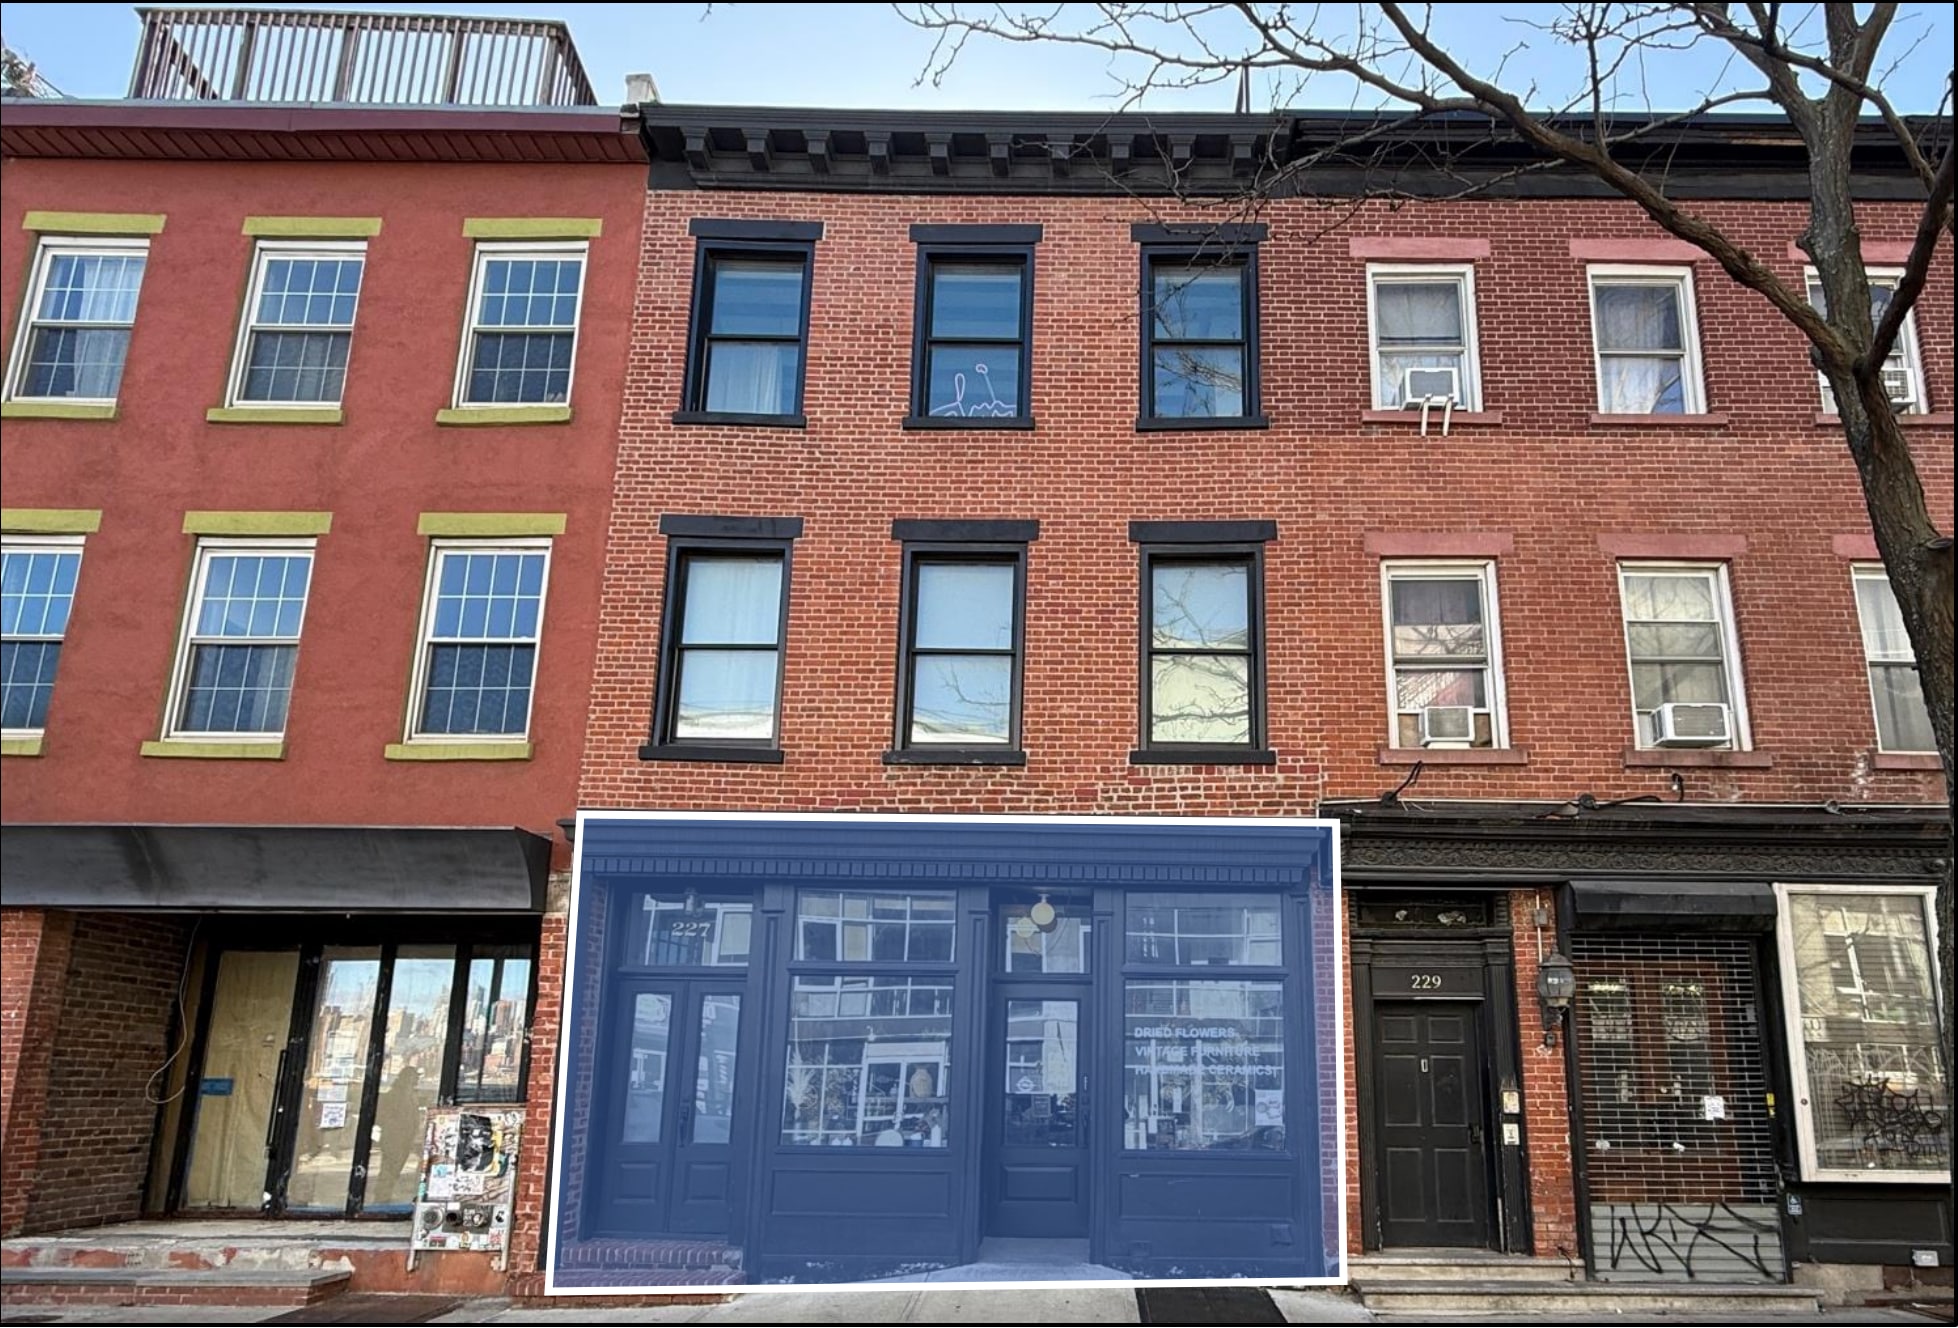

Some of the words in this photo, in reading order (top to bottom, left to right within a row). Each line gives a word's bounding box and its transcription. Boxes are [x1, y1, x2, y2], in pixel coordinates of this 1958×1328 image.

[671, 921, 711, 937] 227
[1411, 974, 1442, 989] 229
[1134, 1027, 1172, 1038] DRIED
[1135, 1046, 1188, 1057] VINTAGE
[1190, 1046, 1260, 1057] FURNITURE
[1135, 1064, 1205, 1075] HADMADE
